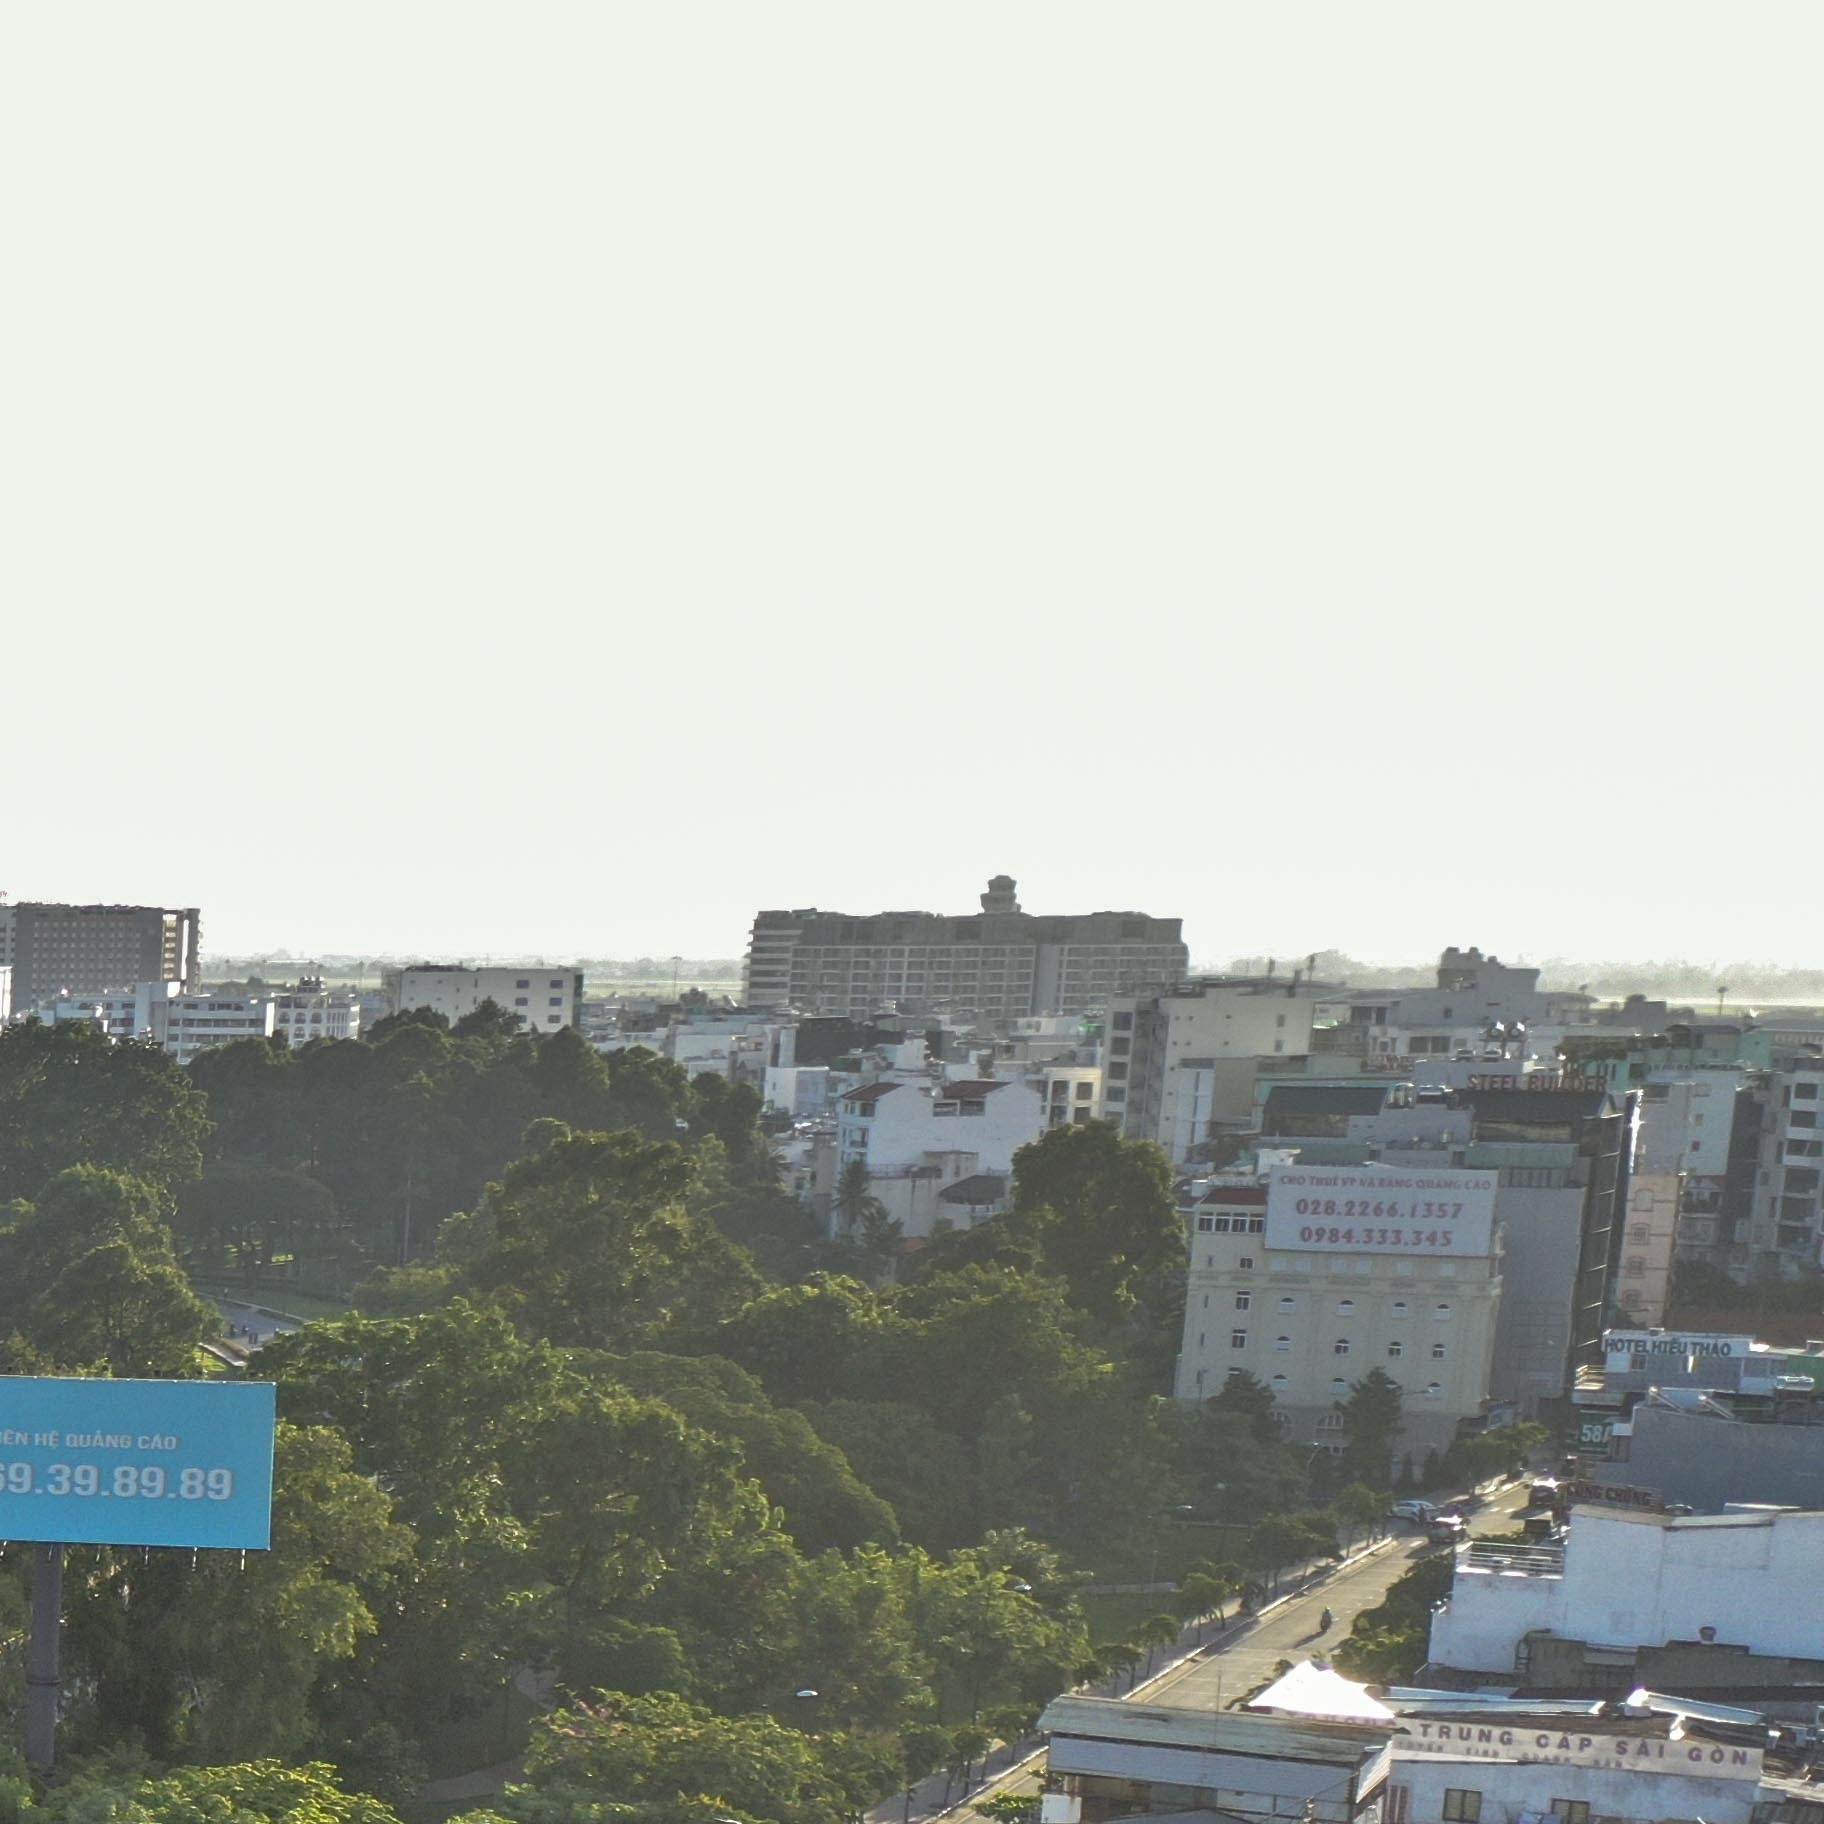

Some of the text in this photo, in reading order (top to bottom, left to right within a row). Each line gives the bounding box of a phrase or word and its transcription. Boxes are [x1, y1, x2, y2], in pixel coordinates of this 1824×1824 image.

[1468, 1074, 1519, 1090] STEEL
[1296, 1199, 1465, 1219] 028.2266.1357
[1301, 1226, 1454, 1246] 0984.333.345
[1604, 1339, 1651, 1353] HOTEL
[34, 1432, 59, 1448] HỆ
[65, 1430, 132, 1449] QUẢNG
[137, 1433, 177, 1450] CÁO
[1419, 1723, 1750, 1766] TRUNG CẤP SÀI GÒN
